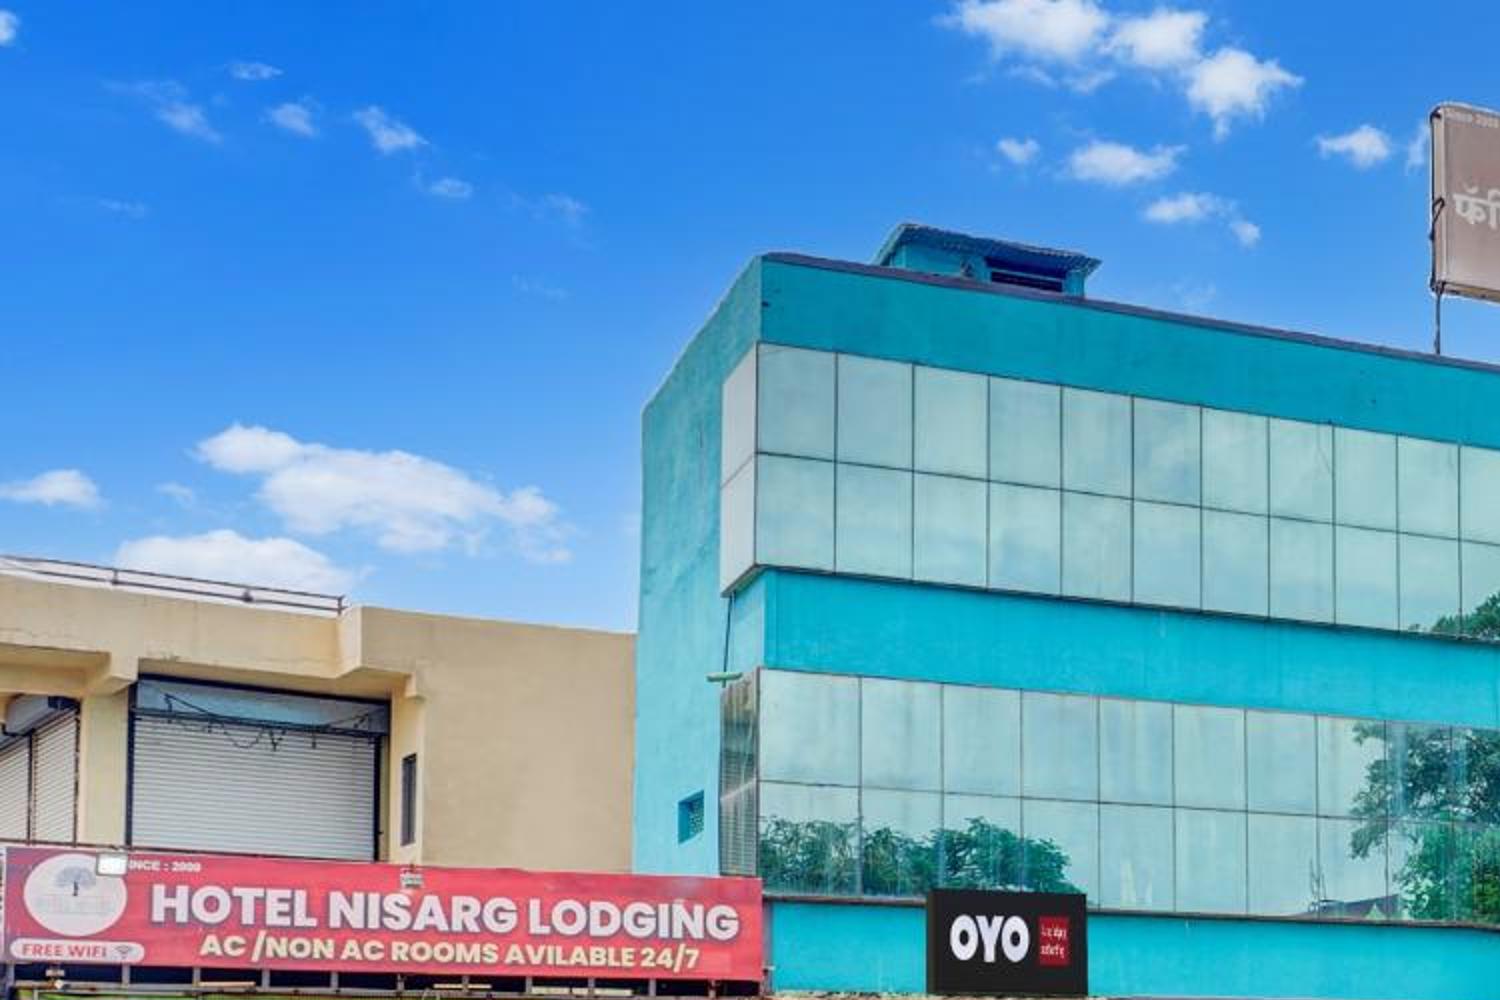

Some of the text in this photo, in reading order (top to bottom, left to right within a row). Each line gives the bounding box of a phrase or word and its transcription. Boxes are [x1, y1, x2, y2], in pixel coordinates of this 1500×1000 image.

[150, 884, 318, 928] HOTEL
[329, 891, 517, 931] NISARG
[528, 898, 740, 940] LODGING
[22, 943, 106, 958] FREE WIFI
[200, 933, 246, 957] AC
[340, 937, 387, 963] AC
[391, 942, 498, 965] ROOMS
[505, 946, 635, 969] AVILABLE
[640, 948, 700, 973] 24/7
[950, 914, 1030, 963] OYO
